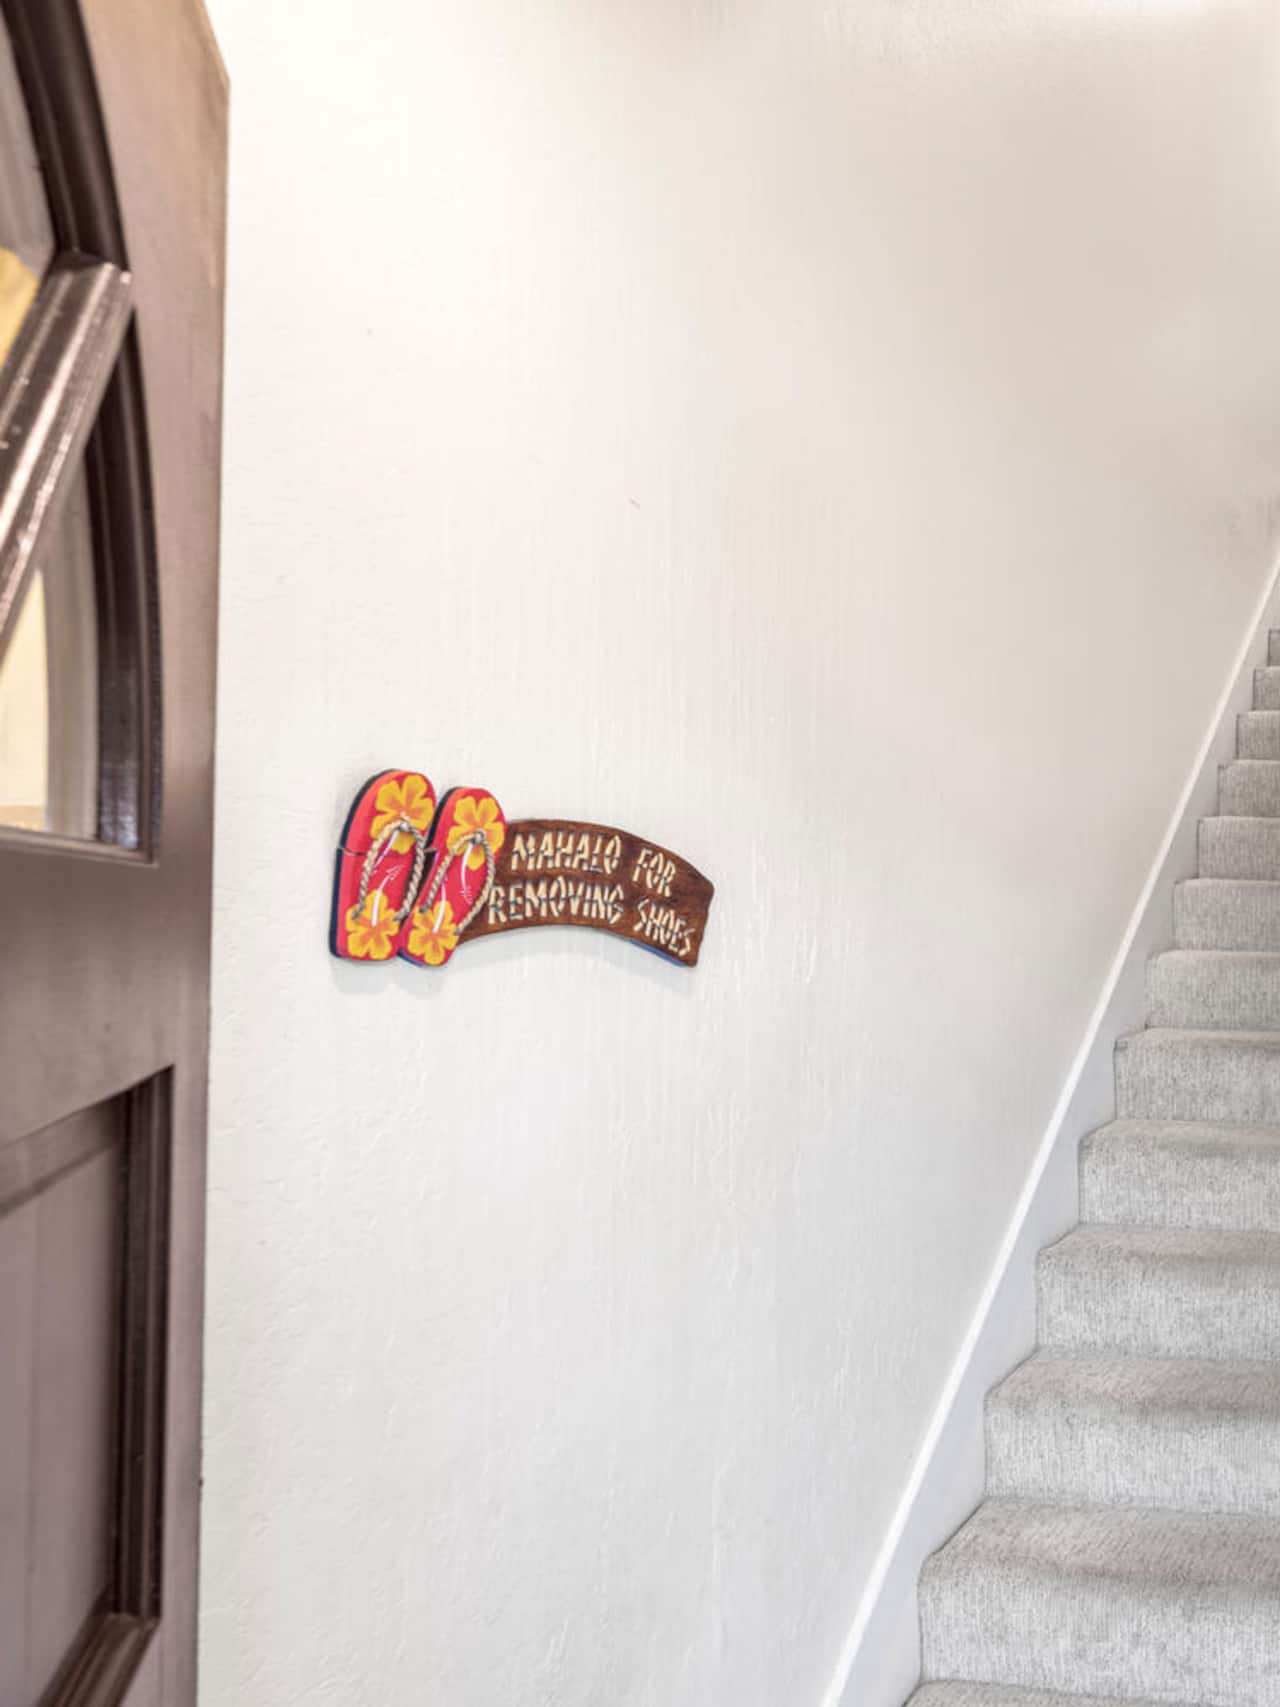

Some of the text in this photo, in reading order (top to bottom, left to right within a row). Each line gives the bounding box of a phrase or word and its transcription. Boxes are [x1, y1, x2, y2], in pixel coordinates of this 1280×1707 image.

[511, 831, 677, 896] MAHALO FOR
[487, 876, 694, 956] REMOVING SHOES
